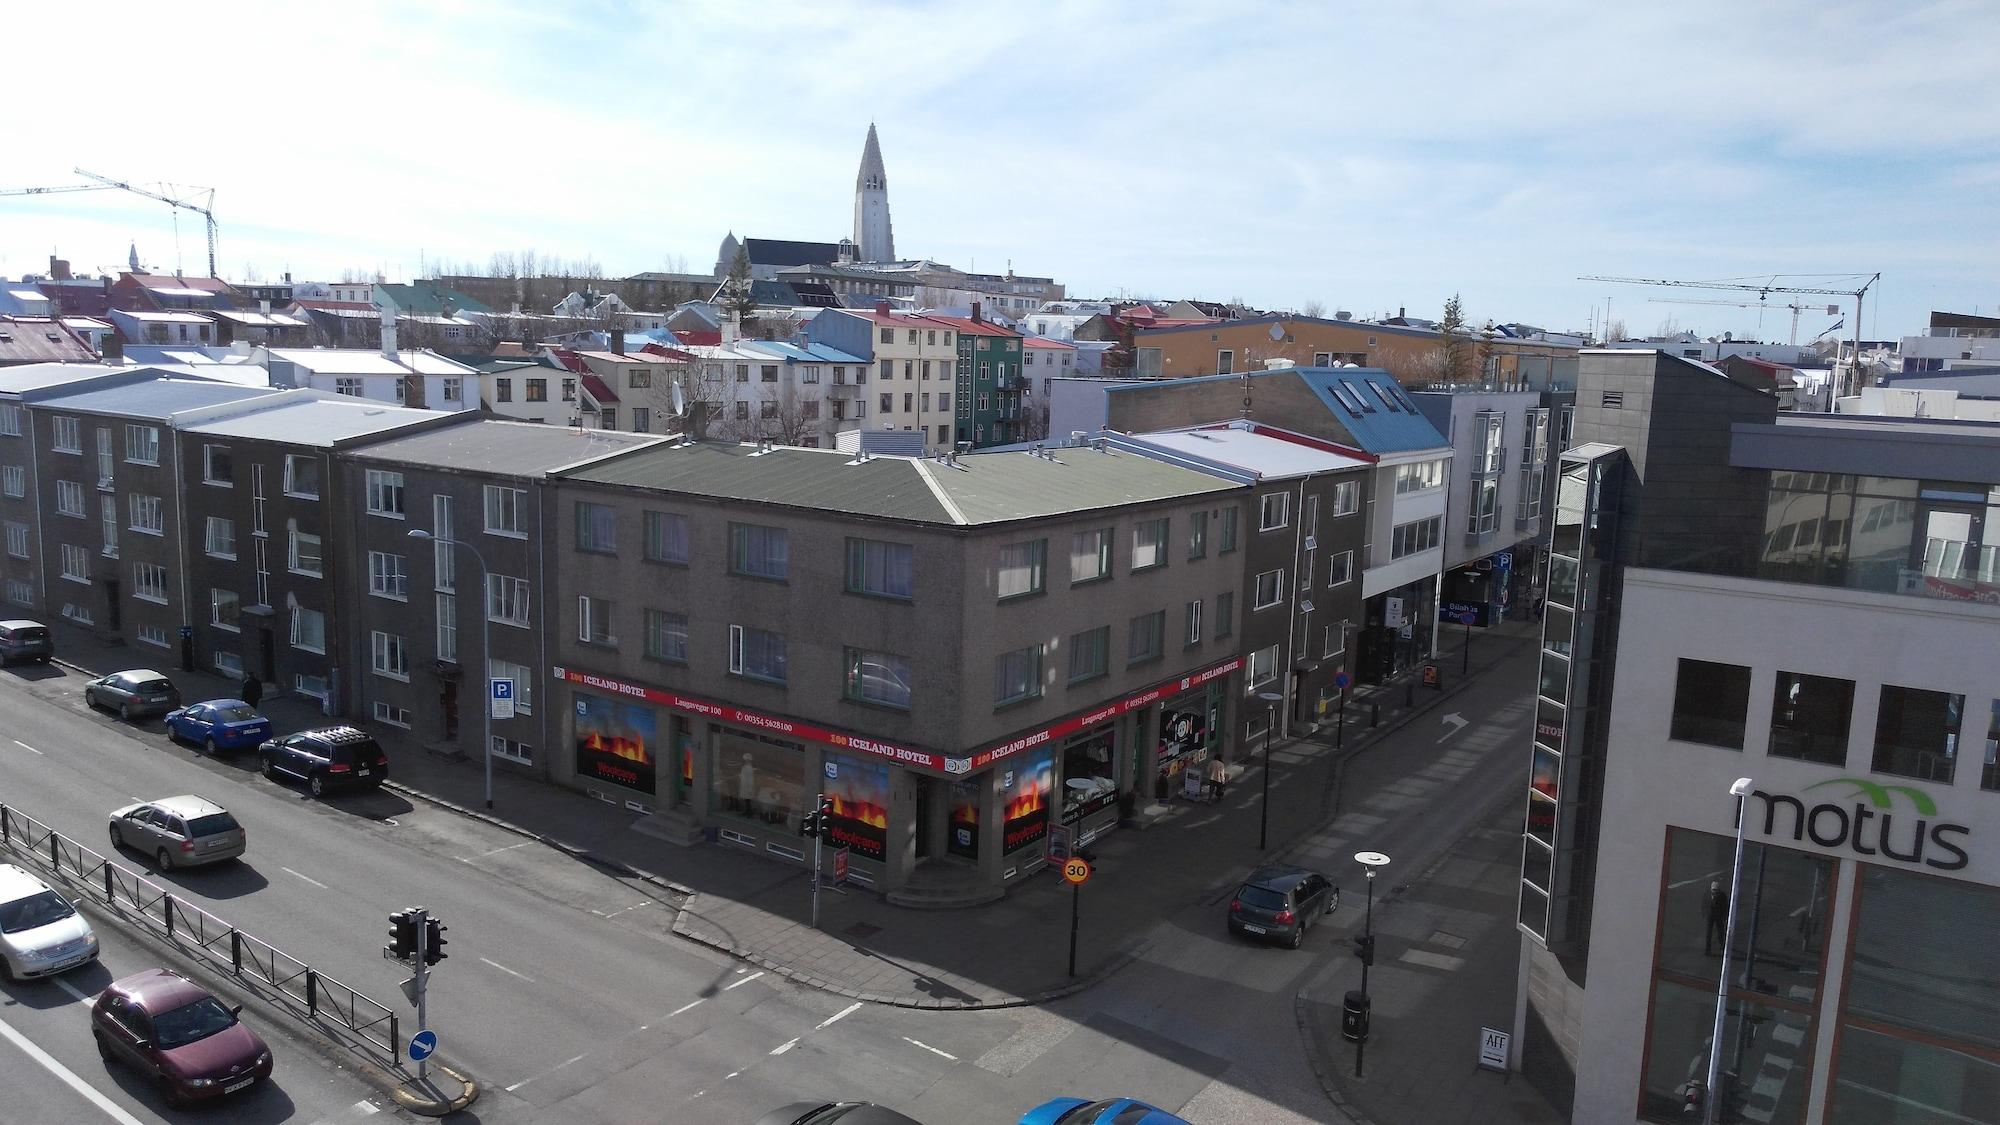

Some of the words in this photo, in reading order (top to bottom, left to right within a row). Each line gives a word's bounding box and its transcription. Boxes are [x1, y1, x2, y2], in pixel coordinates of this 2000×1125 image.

[1500, 557, 1509, 567] P
[1201, 666, 1224, 681] ICELAND
[1223, 661, 1239, 674] HOTEL
[497, 684, 507, 696] P
[569, 672, 582, 683] 100
[583, 674, 618, 691] ICELAND
[619, 681, 647, 698] HOTEL
[674, 697, 710, 713] Laugavegur
[710, 706, 722, 716] 100
[744, 714, 764, 726] 00354
[765, 718, 793, 732] 5628100
[830, 734, 847, 746] 100
[848, 737, 894, 757] ICELAND
[896, 748, 932, 766] HOTEL
[977, 753, 991, 767] 100
[991, 739, 1025, 760] ICELAND
[1026, 730, 1050, 747] HOTEL
[832, 826, 881, 849] Woolcano
[1734, 789, 1971, 871] motus
[1067, 864, 1086, 877] 30
